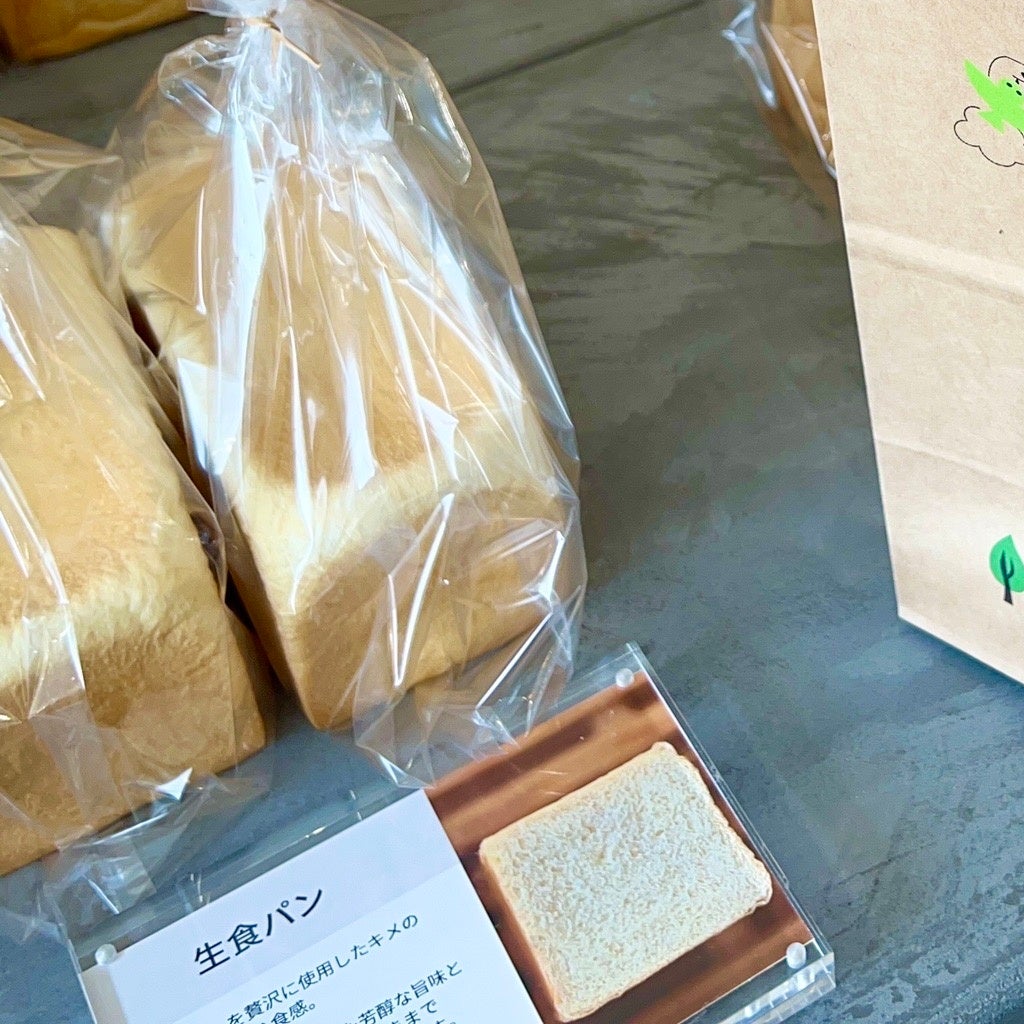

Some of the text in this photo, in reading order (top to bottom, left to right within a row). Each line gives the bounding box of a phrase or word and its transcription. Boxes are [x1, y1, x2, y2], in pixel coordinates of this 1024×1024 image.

[193, 888, 323, 976] 生食パン
[262, 999, 316, 1024] 食感。
[347, 961, 463, 1024] 芳醇な旨味と
